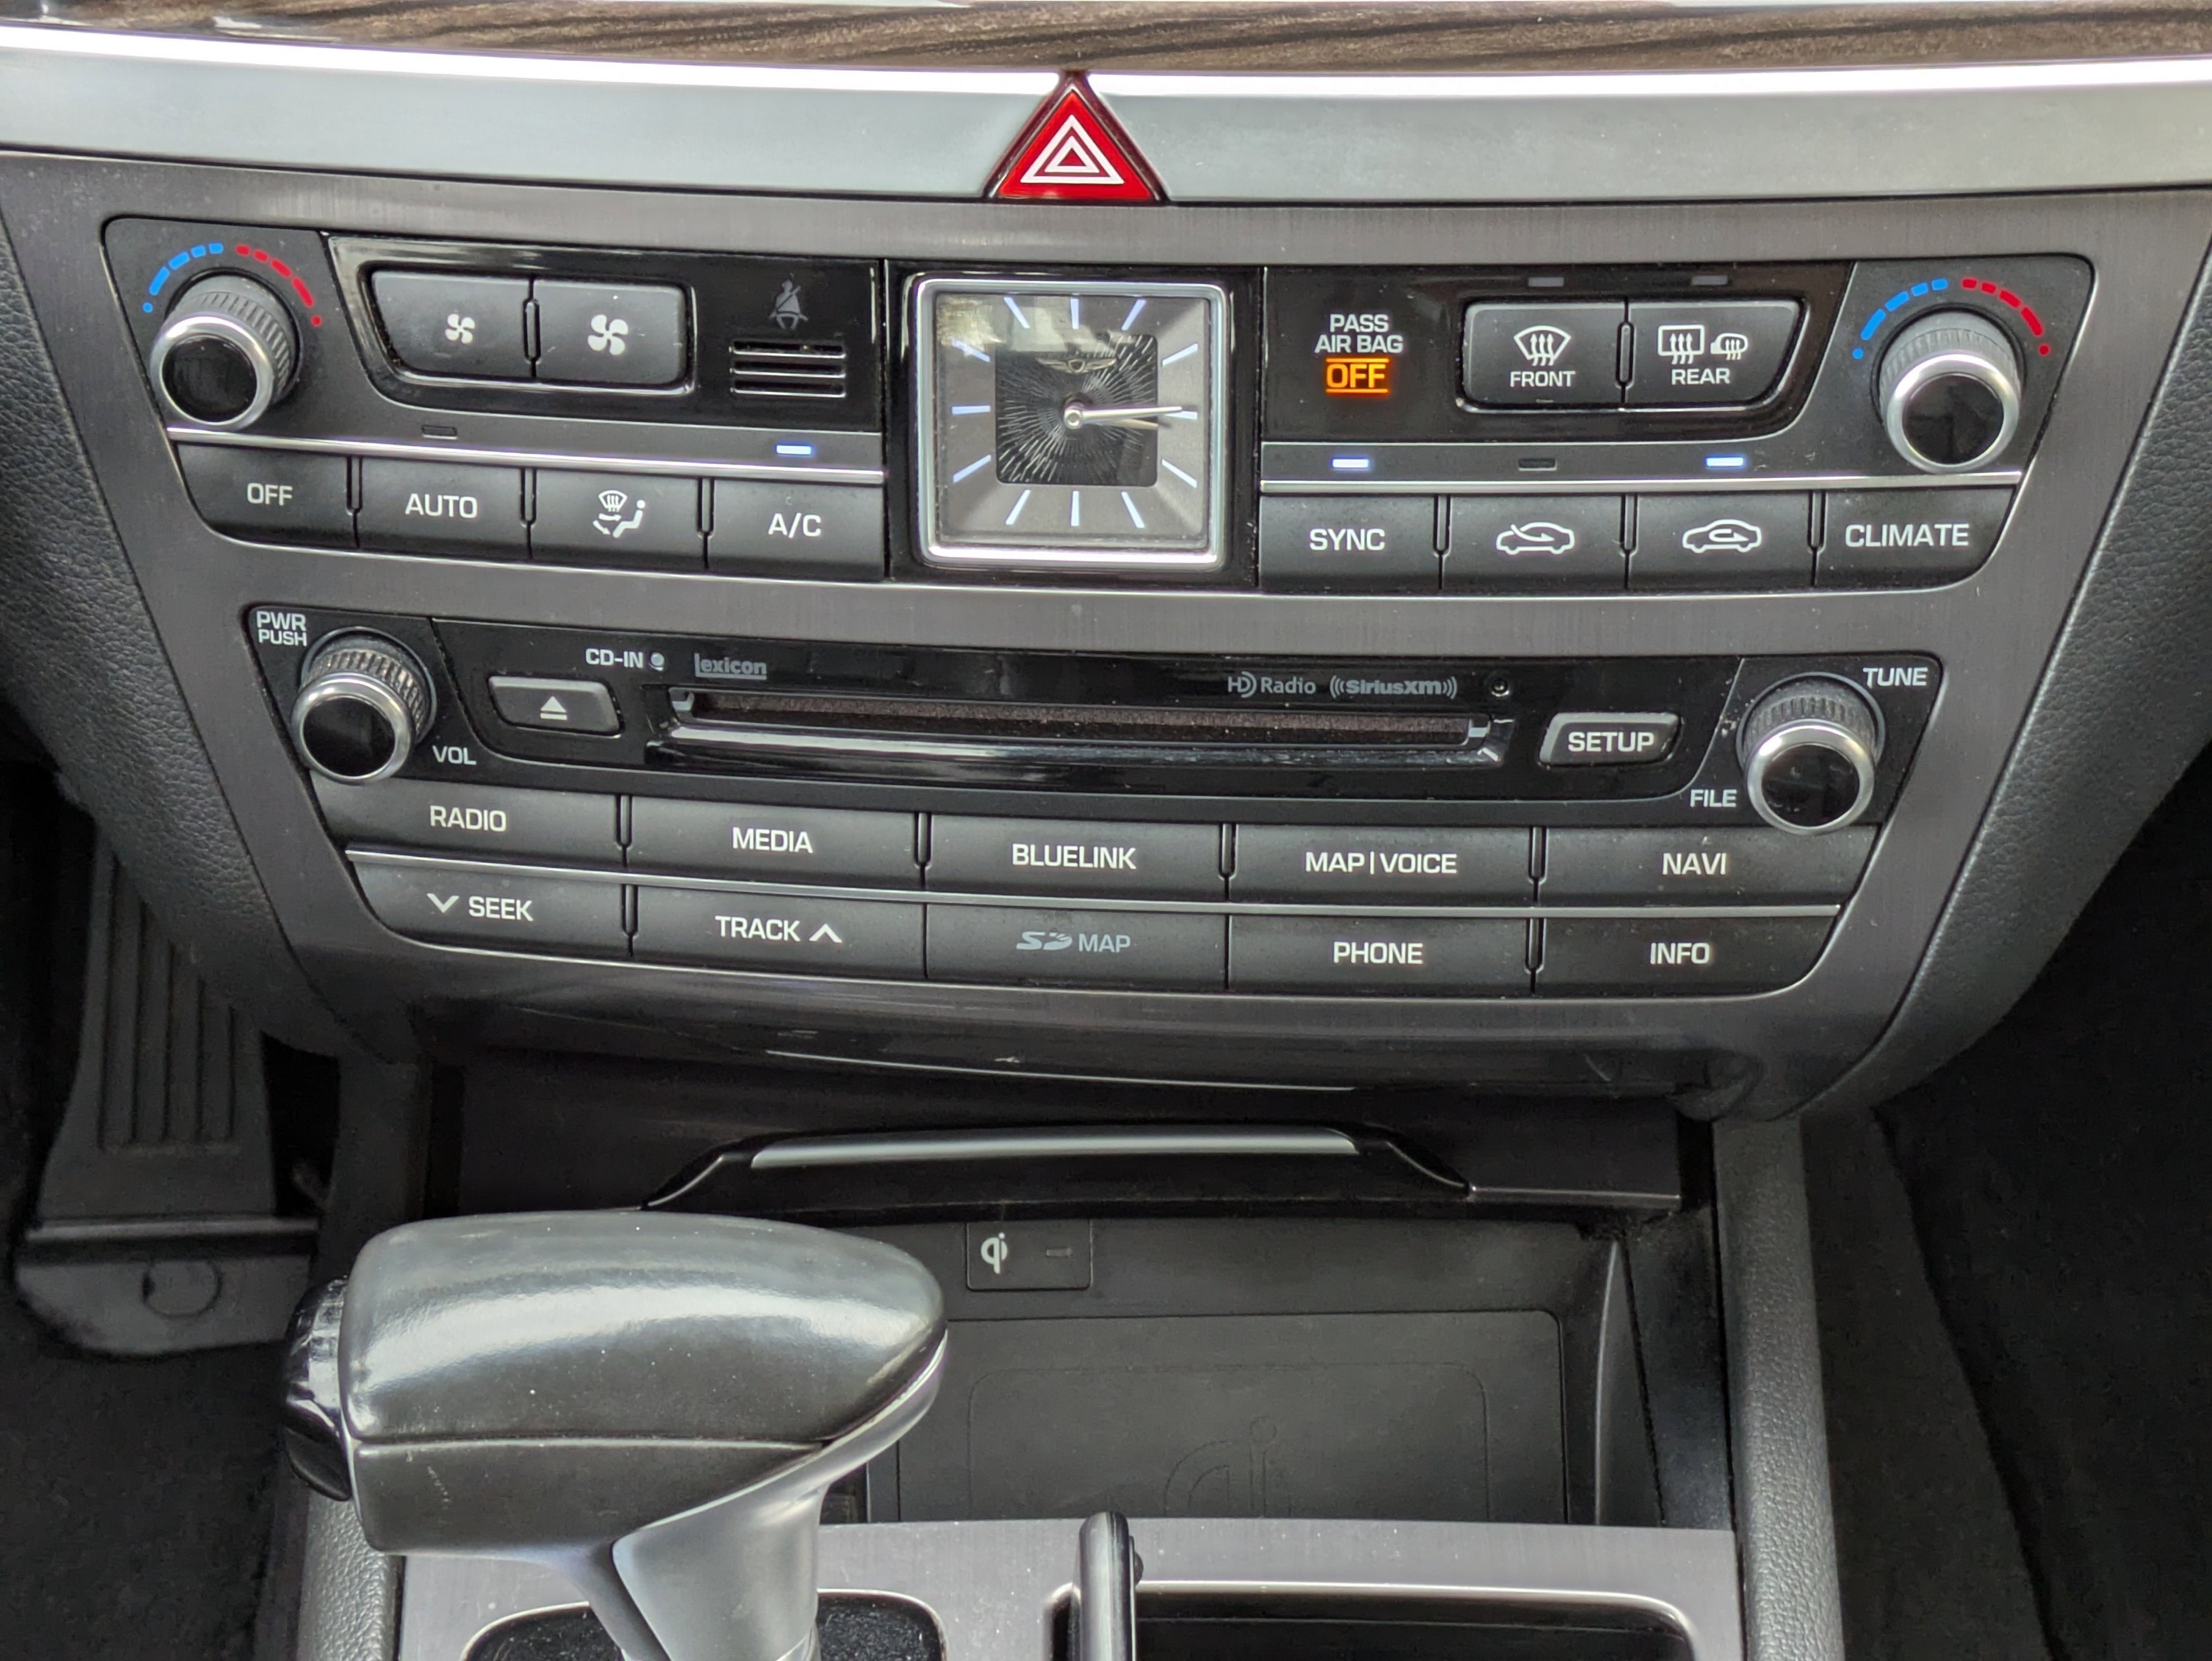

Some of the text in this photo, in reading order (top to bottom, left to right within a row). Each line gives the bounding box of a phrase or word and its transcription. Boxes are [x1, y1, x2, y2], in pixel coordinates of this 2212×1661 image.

[1330, 314, 1389, 332] PASS
[1315, 335, 1403, 353] AIR BAG
[1327, 364, 1387, 388] OFF
[1510, 371, 1575, 387] FRONT
[1672, 368, 1730, 385] REAR
[247, 483, 292, 505] OFF
[406, 493, 477, 518] AUTO
[768, 513, 821, 538] A/C
[1846, 523, 1969, 547] CLIMATE
[1310, 529, 1385, 550] SYNC
[257, 611, 306, 631] PWR
[258, 629, 307, 646] PUSH
[586, 649, 643, 668] CD-IN
[694, 653, 766, 680] lexicon
[1261, 676, 1316, 694] Radio
[1863, 667, 1928, 688] TUNE
[1569, 732, 1654, 752] SETUP
[433, 746, 476, 765] VOL
[1691, 789, 1736, 807] FILE
[431, 806, 506, 831] RADIO
[733, 827, 813, 853] MEDIA
[1013, 843, 1136, 869] BLUELINK
[1663, 853, 1726, 875] NAVI
[469, 896, 533, 921] SEEK
[715, 916, 800, 941] TRACK
[1079, 934, 1130, 952] MAP
[1334, 942, 1423, 964] PHONE
[1650, 943, 1710, 964] INFO
